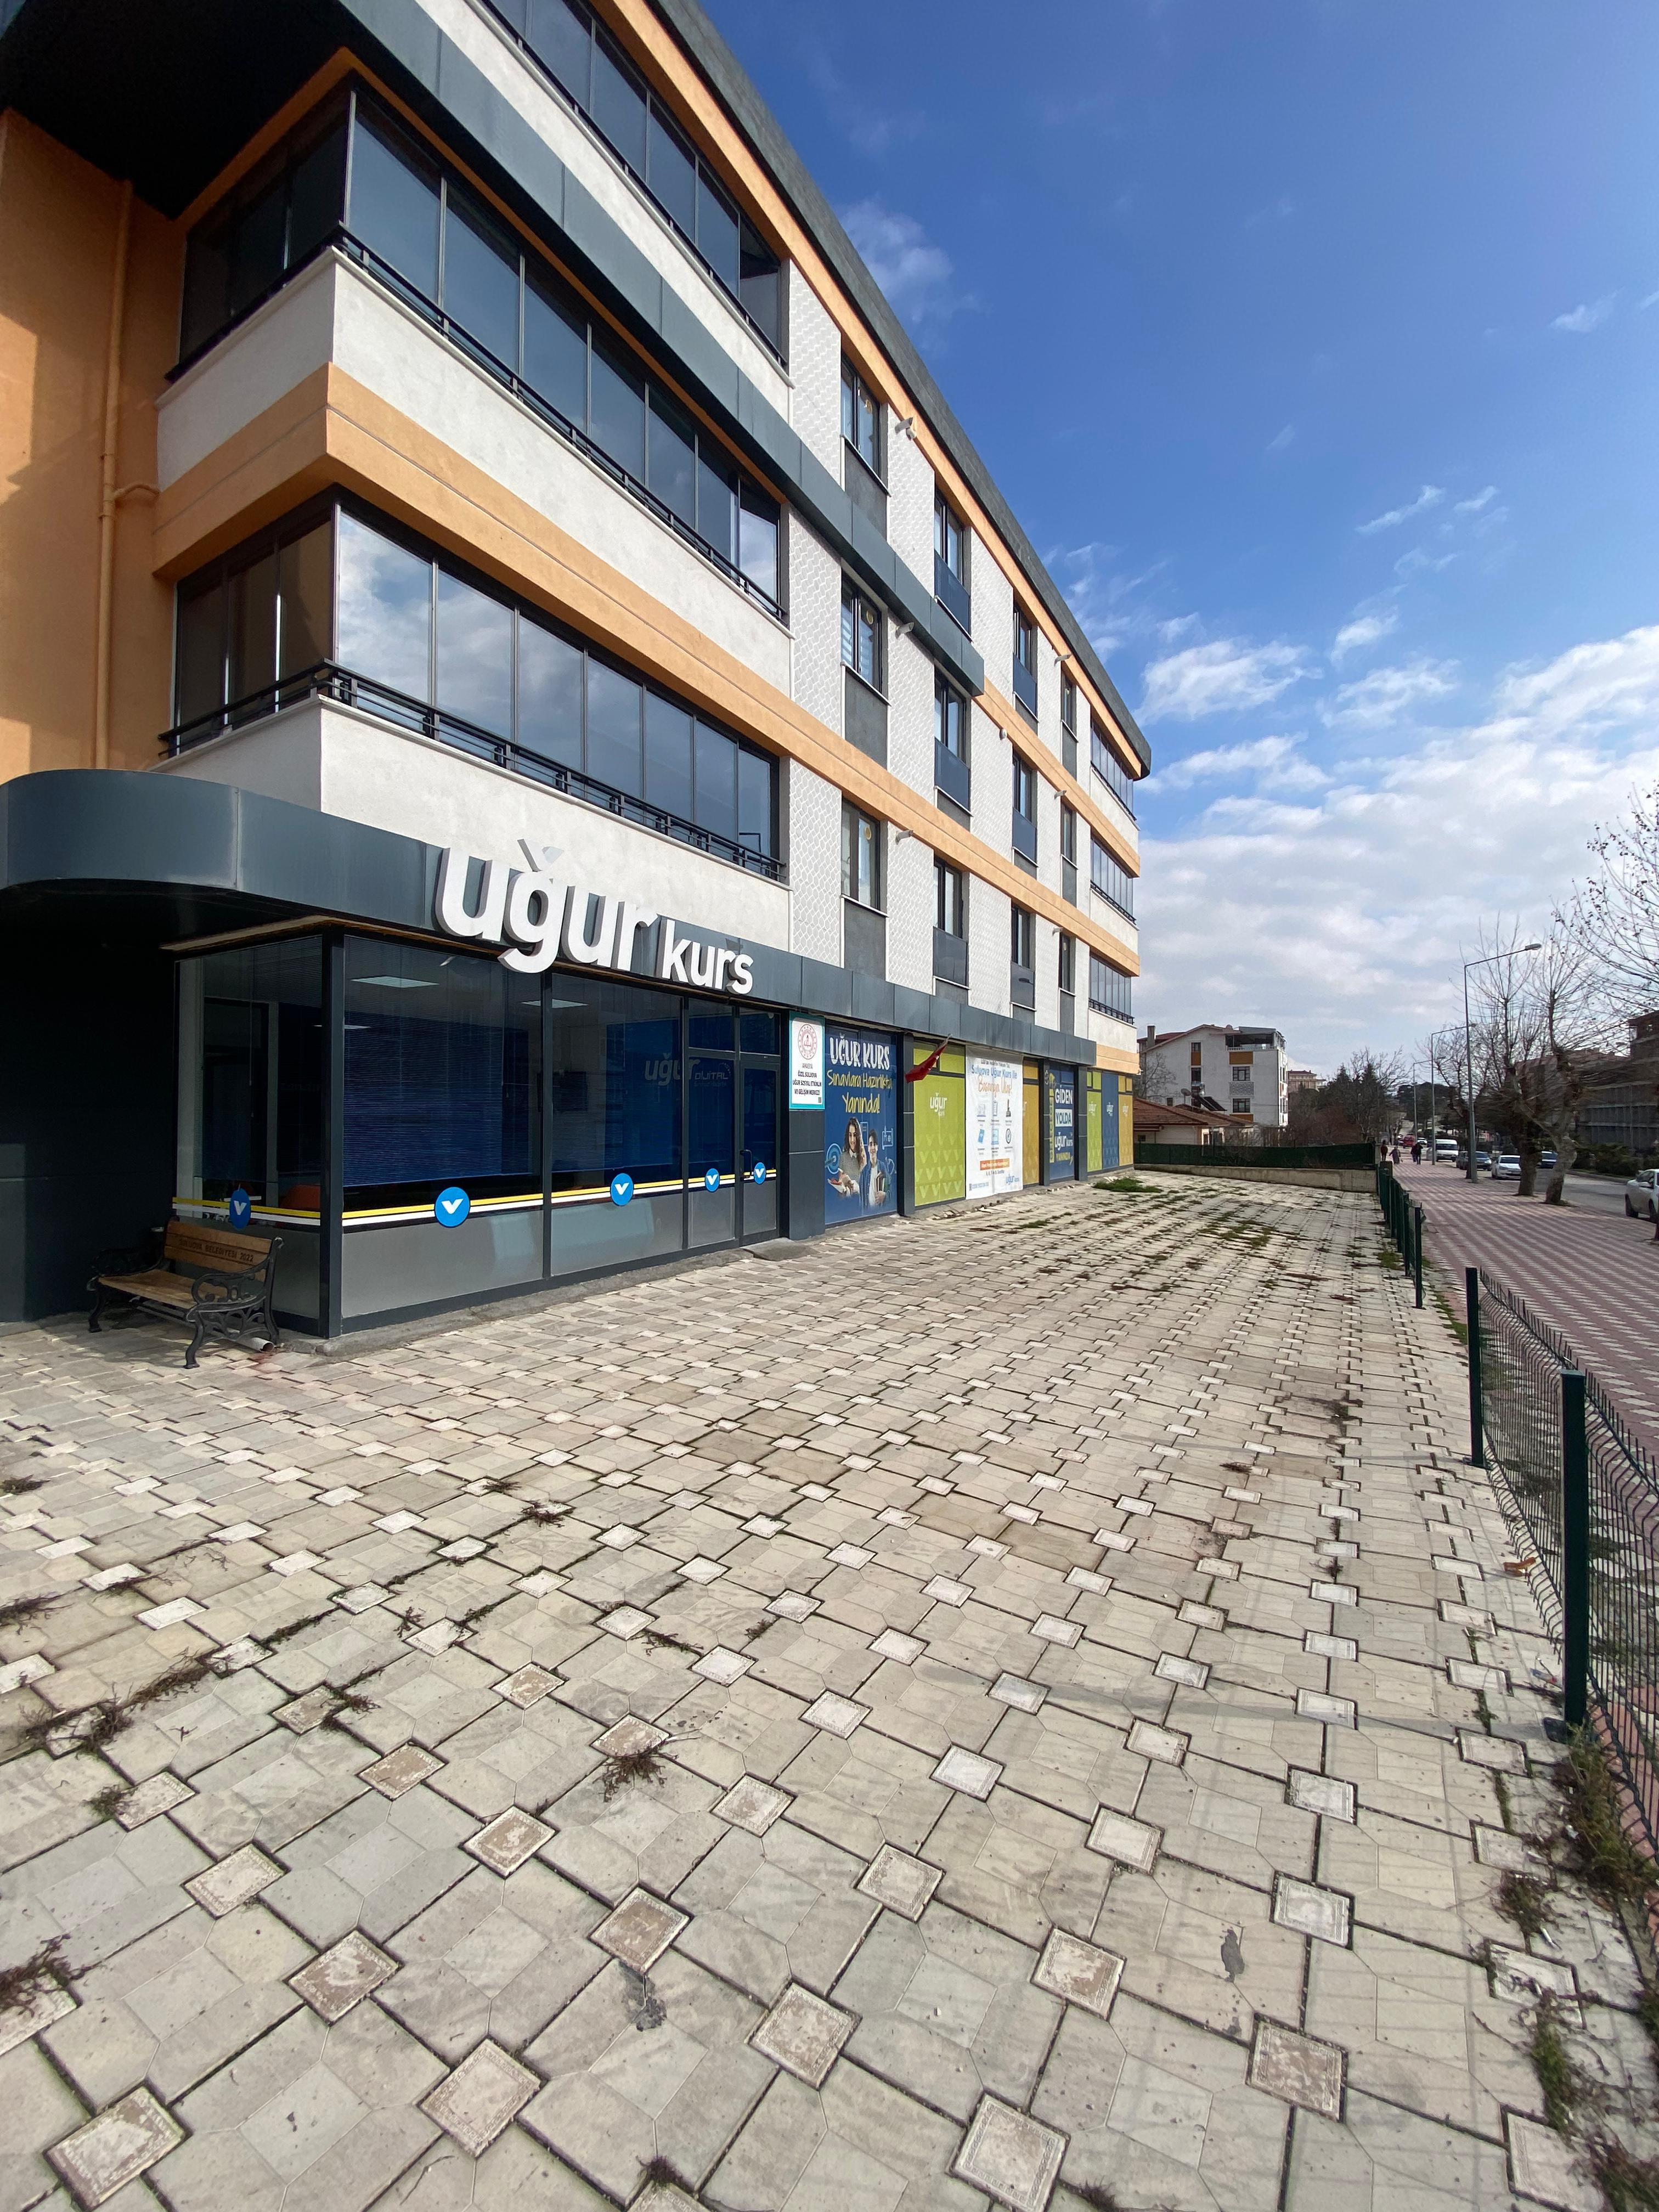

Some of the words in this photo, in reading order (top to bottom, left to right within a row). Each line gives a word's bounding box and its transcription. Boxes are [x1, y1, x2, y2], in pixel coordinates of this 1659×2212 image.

[435, 838, 660, 974] uğur
[658, 917, 754, 995] kurs
[830, 1032, 861, 1068] UĞUR
[863, 1042, 890, 1070] KURS
[827, 1069, 861, 1088] Sınavlara
[990, 1067, 1001, 1079] Uğur
[1002, 1069, 1012, 1079] Kurs
[842, 1091, 881, 1114] Yanında!
[930, 1092, 948, 1113] uğur
[1054, 1084, 1073, 1104] GİDEN
[1056, 1112, 1072, 1125] YOLDA
[1054, 1132, 1067, 1151] uğur
